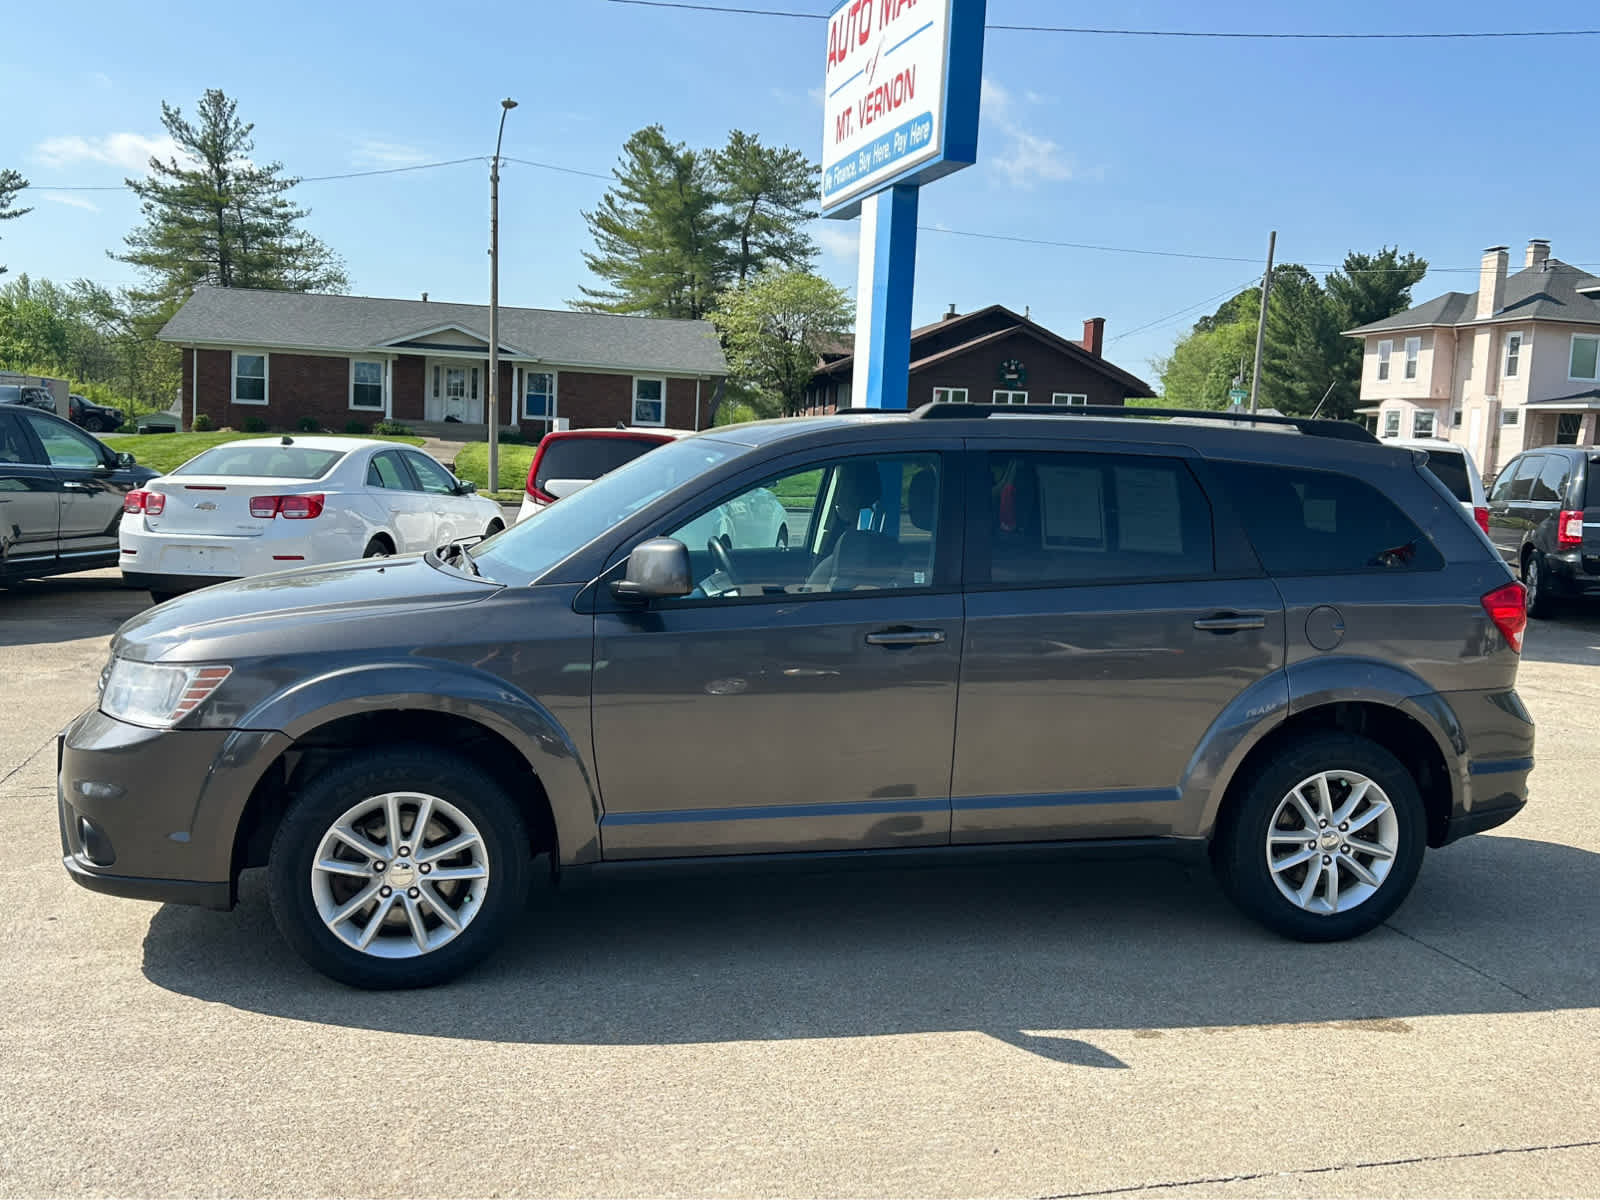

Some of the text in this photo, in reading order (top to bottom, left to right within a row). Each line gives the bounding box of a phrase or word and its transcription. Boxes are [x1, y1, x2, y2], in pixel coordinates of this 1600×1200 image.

[827, 0, 873, 74] AUTO
[835, 64, 916, 145] MT. VERNON
[910, 120, 930, 146] Here
